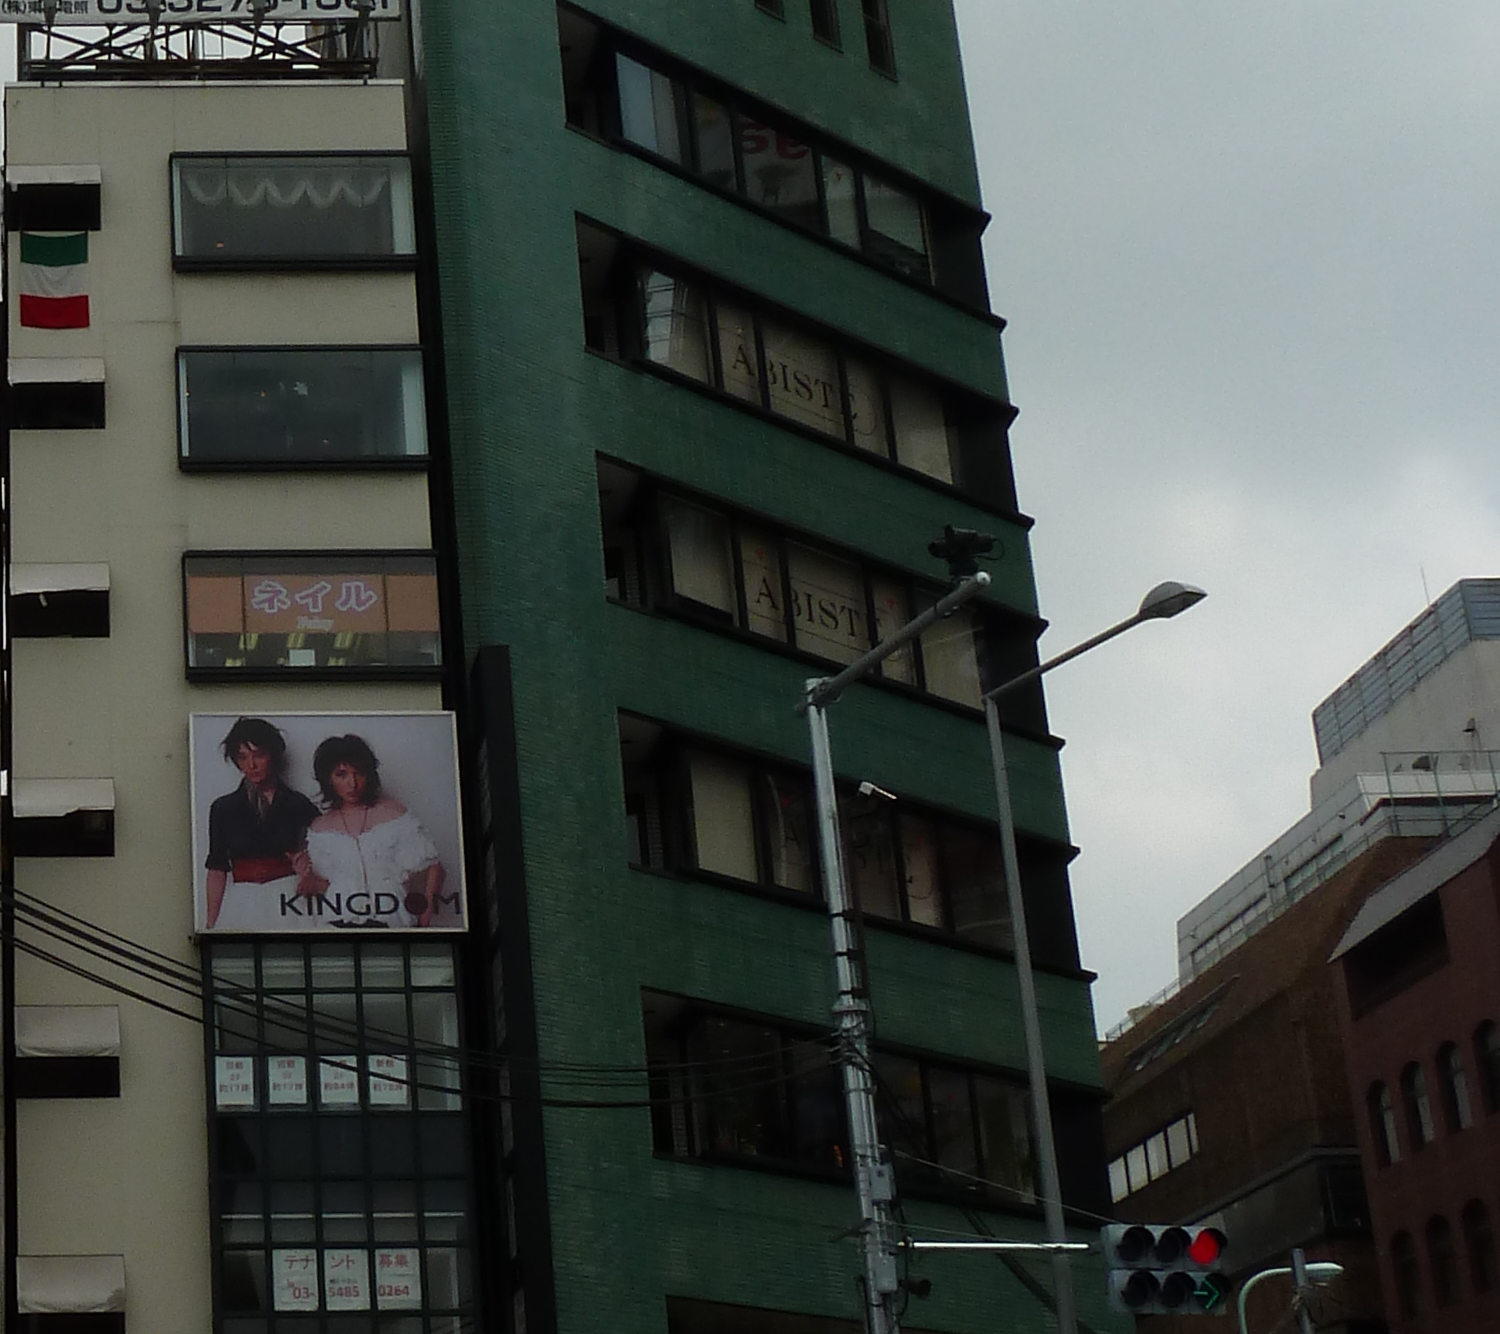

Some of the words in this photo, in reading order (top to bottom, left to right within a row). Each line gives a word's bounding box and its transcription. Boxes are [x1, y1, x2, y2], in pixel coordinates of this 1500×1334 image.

[251, 580, 378, 614] ネイル
[280, 891, 461, 917] KINGDOM
